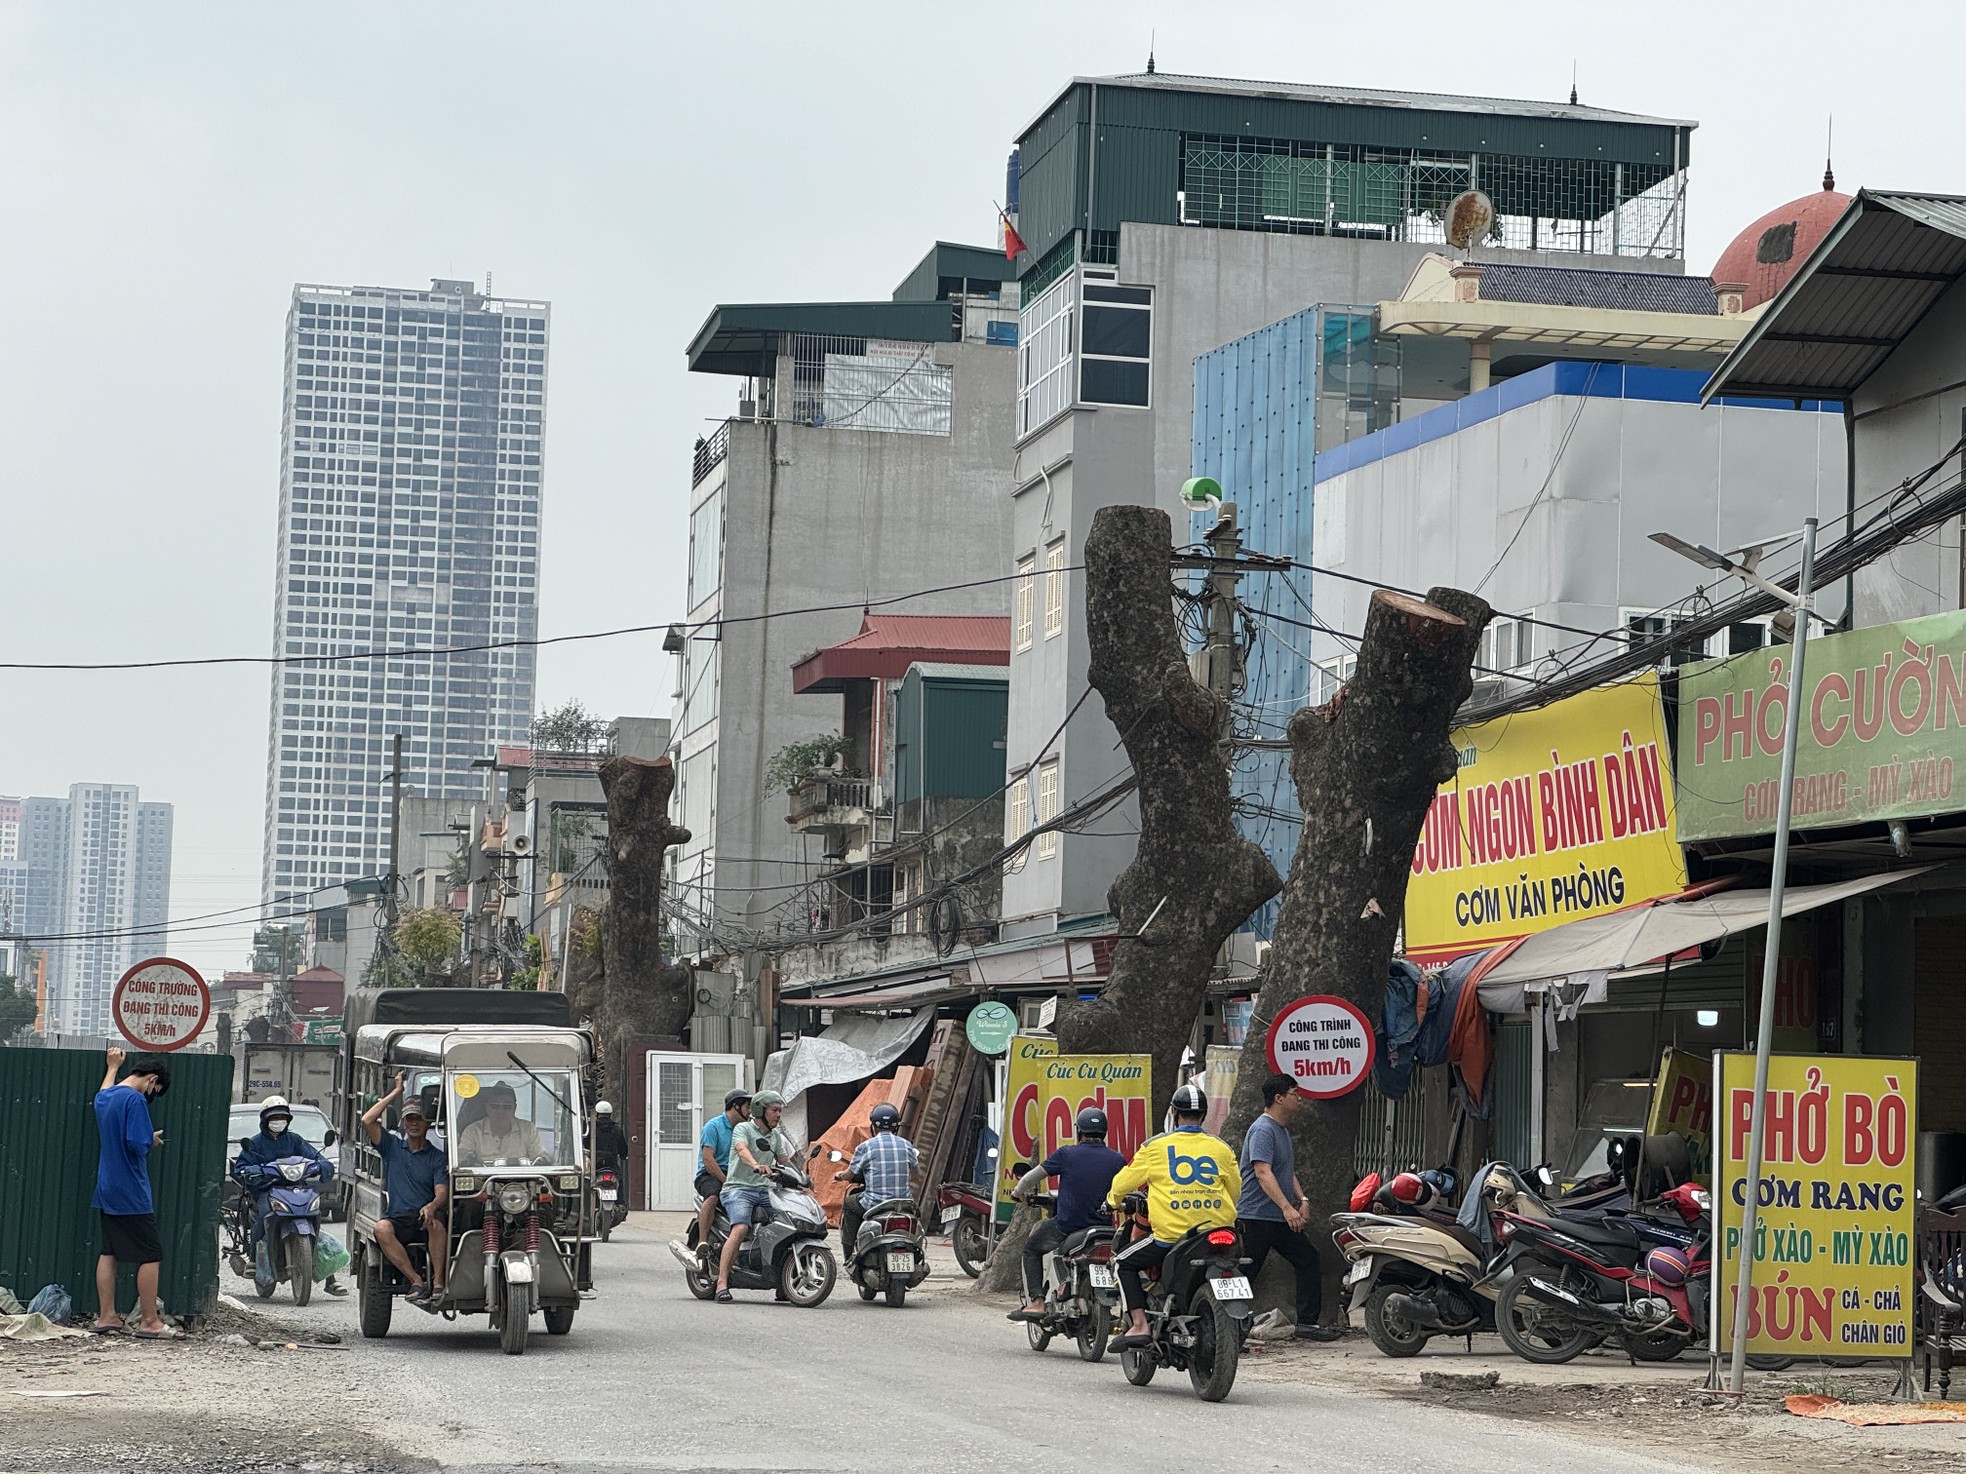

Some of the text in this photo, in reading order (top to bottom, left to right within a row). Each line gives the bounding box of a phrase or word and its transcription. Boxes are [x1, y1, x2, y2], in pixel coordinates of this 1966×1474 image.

[1466, 774, 1536, 867] NGON
[1538, 750, 1604, 854] BÌNH
[1603, 730, 1668, 841] DÂN
[1792, 770, 1847, 816] RANG
[1868, 754, 1902, 808] MỲ
[1908, 750, 1953, 801] XÀO
[1455, 862, 1625, 926] CƠM VĂN PHÒNG
[128, 978, 197, 996] CÔNG TRƯỜNG
[123, 1001, 198, 1017] ĐANG THI CÔNG
[1289, 1018, 1351, 1033] CÔNG TRÌNH
[1281, 1036, 1361, 1052] ĐANG THI CÔNG
[1047, 1061, 1142, 1083] Cúc Cu Quán
[1294, 1057, 1351, 1076] 5km/h
[1730, 1066, 1831, 1165] PHỞ
[1843, 1075, 1908, 1169] BÒ
[1167, 1145, 1219, 1185] be
[1732, 1174, 1904, 1212] CƠM RANG
[1726, 1217, 1767, 1262] PỞ
[1772, 1222, 1812, 1264] XÀO
[1832, 1225, 1864, 1265] MỲ
[1868, 1226, 1908, 1266] XÀO
[1729, 1269, 1836, 1342] BÚN
[1841, 1286, 1860, 1310] CÁ
[1873, 1285, 1901, 1311] CHẢ
[1841, 1320, 1906, 1345] CHÂN GIÒ
